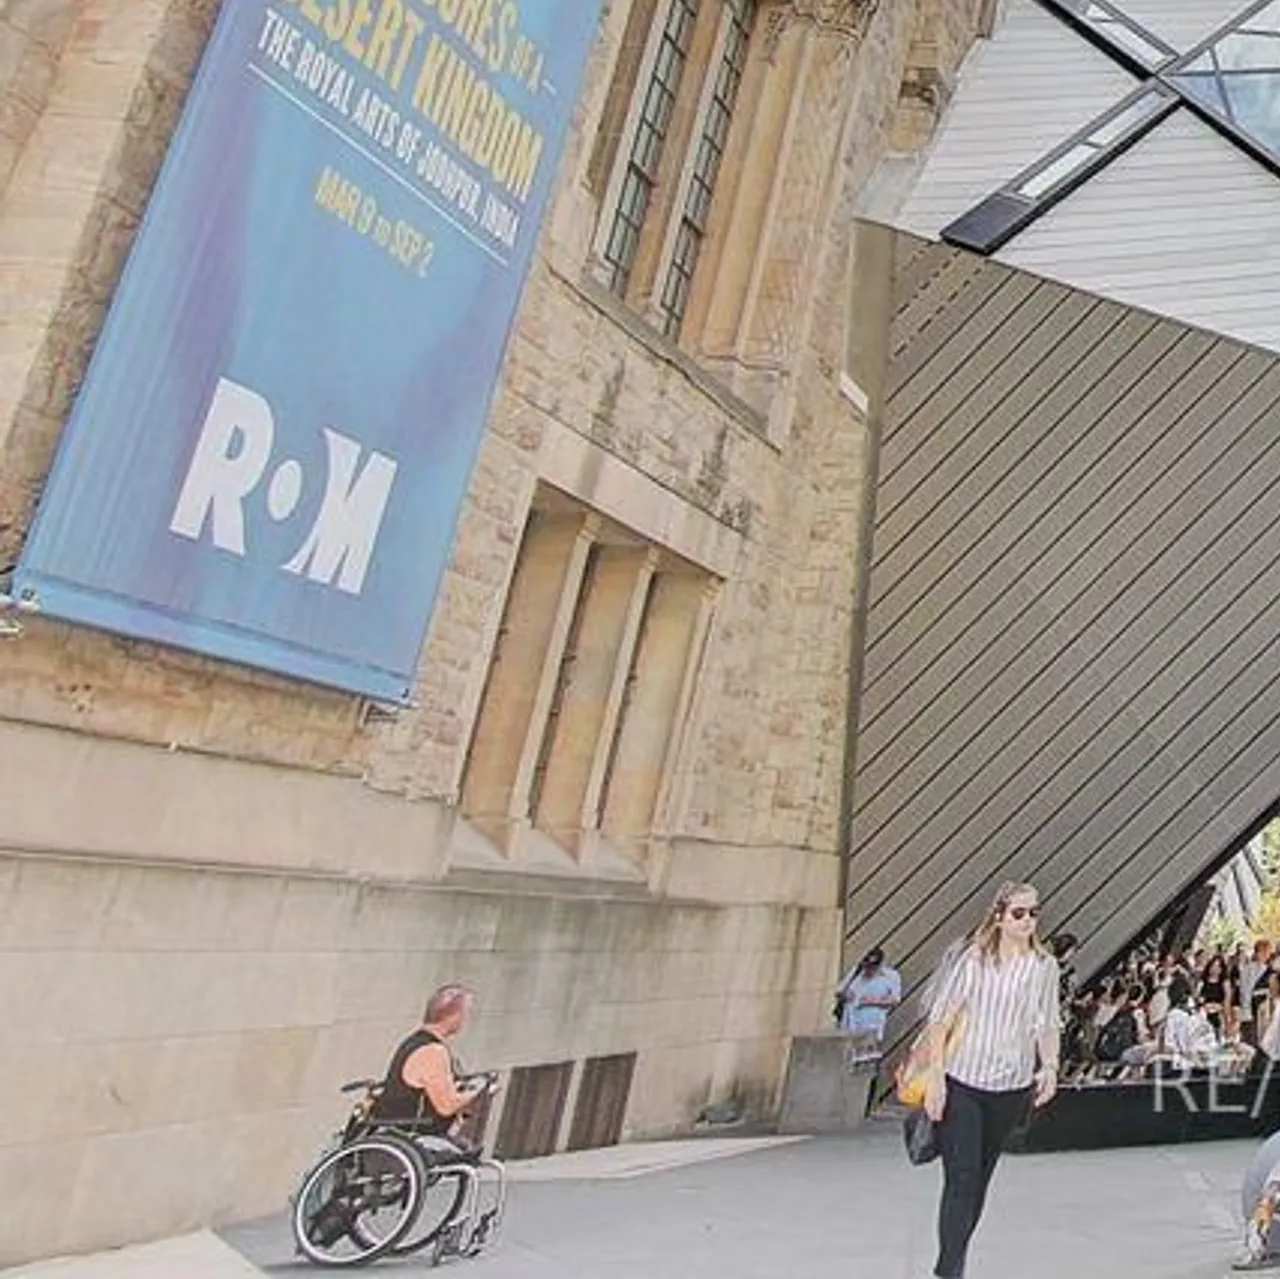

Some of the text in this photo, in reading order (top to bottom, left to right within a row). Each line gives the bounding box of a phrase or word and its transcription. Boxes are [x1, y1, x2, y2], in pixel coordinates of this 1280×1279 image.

[257, 7, 302, 71] THE
[294, 39, 356, 116] ROYAL
[350, 87, 400, 148] ARTS
[396, 121, 422, 164] OF
[412, 33, 544, 204] KINGDOM
[315, 164, 361, 227] MAR
[356, 196, 377, 235] 9
[387, 219, 424, 267] SEP
